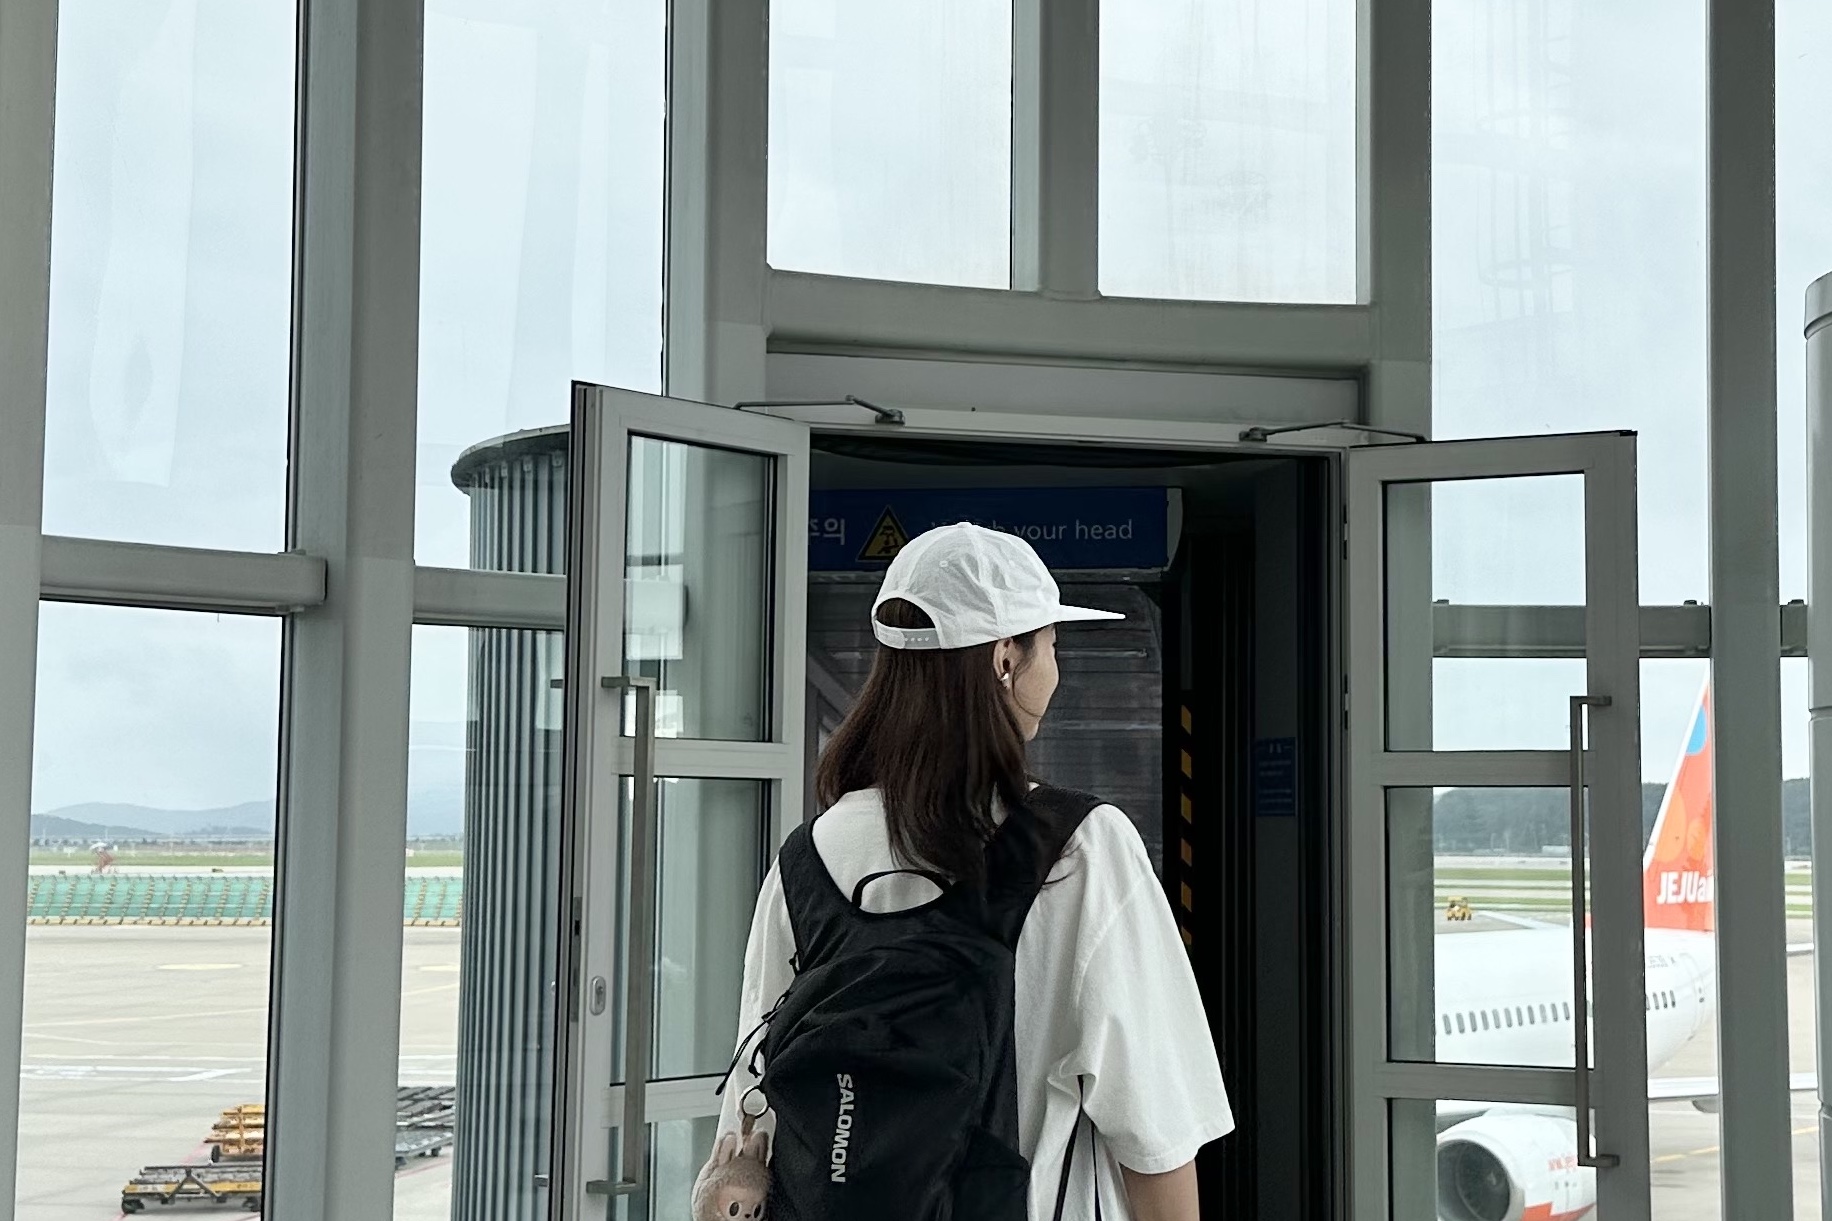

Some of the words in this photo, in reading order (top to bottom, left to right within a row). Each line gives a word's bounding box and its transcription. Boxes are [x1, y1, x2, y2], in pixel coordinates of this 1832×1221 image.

[1013, 521, 1067, 540] your
[1075, 518, 1133, 540] head
[830, 1073, 855, 1183] SALOMON
